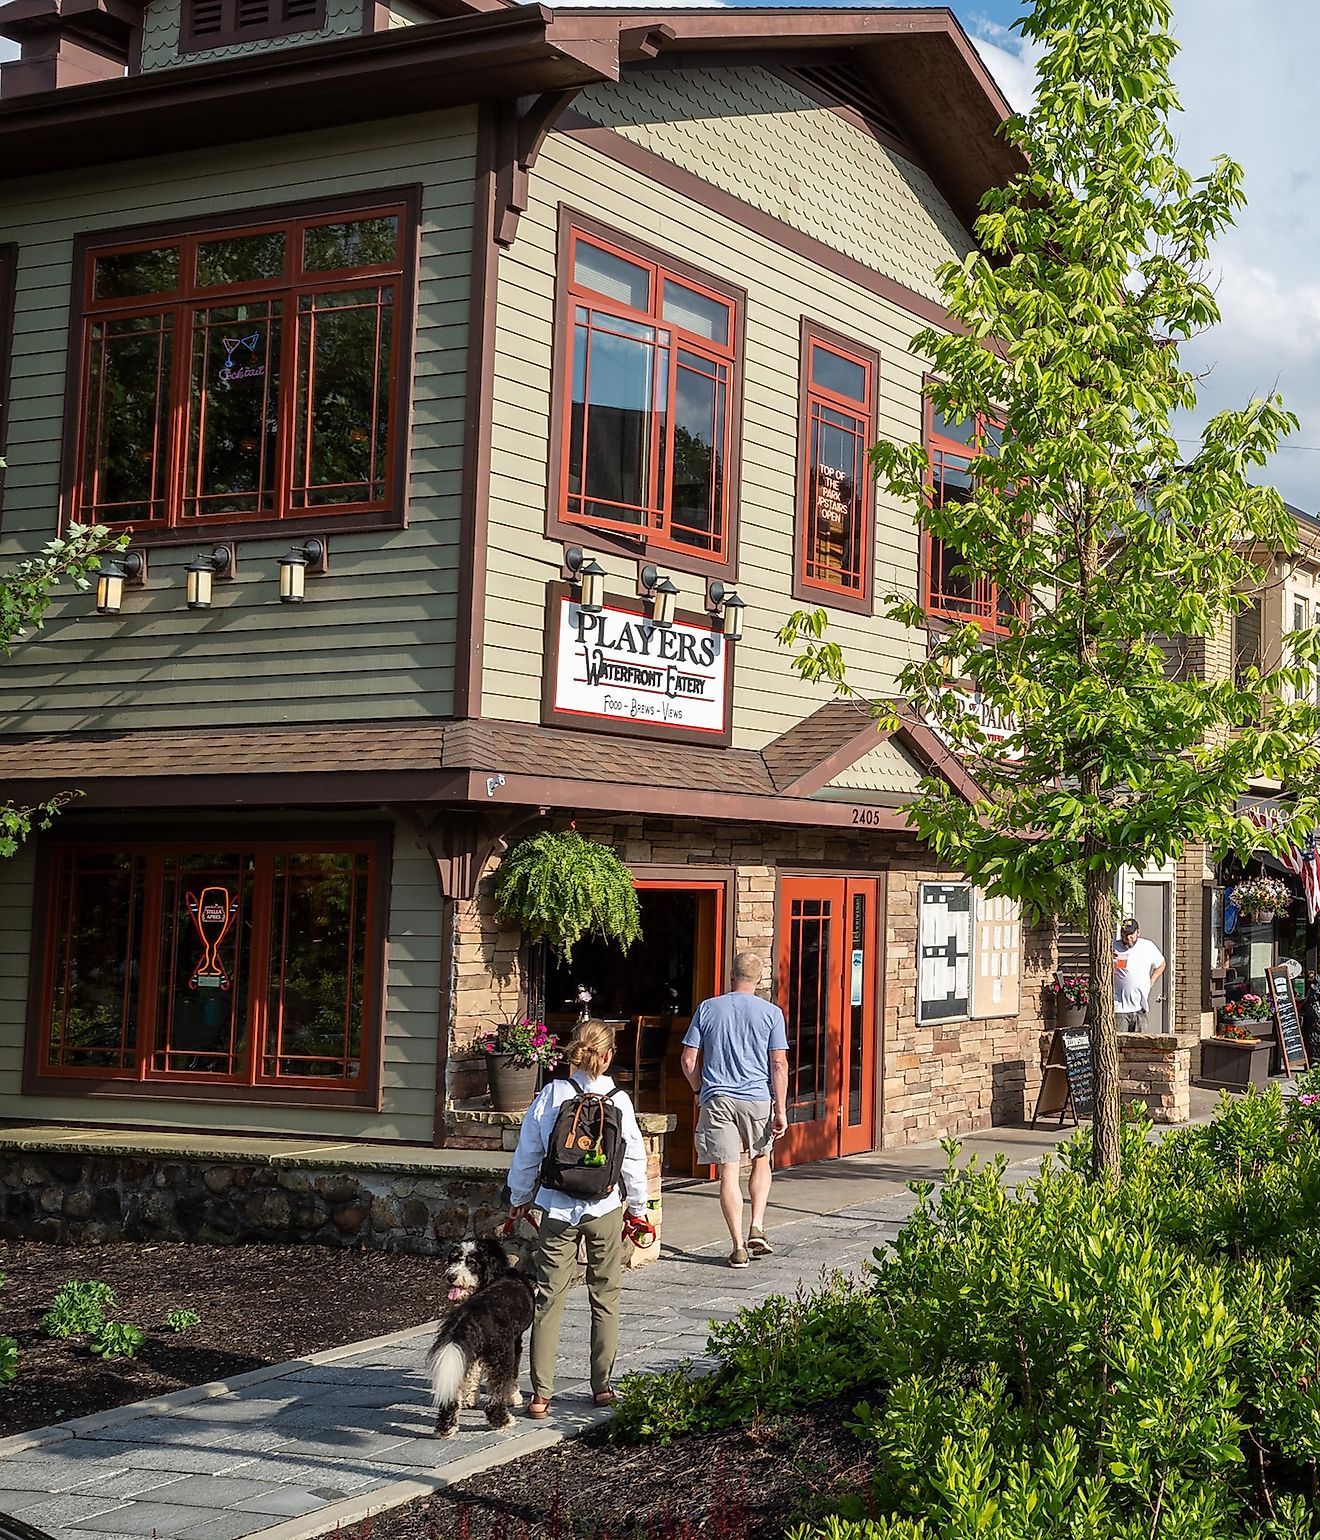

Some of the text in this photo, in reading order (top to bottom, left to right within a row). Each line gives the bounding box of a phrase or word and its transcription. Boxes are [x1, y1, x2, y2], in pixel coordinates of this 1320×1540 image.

[819, 463, 846, 480] TOP OF
[825, 477, 839, 491] THE
[822, 486, 841, 502] PARK
[821, 508, 841, 523] OPEN
[574, 611, 716, 667] PLAYERS
[583, 645, 706, 699] WATERFRONT EATERY
[603, 694, 622, 713] FOOD
[630, 698, 654, 717] BREWS
[662, 701, 683, 721] VIEWS
[852, 808, 880, 826] 2405
